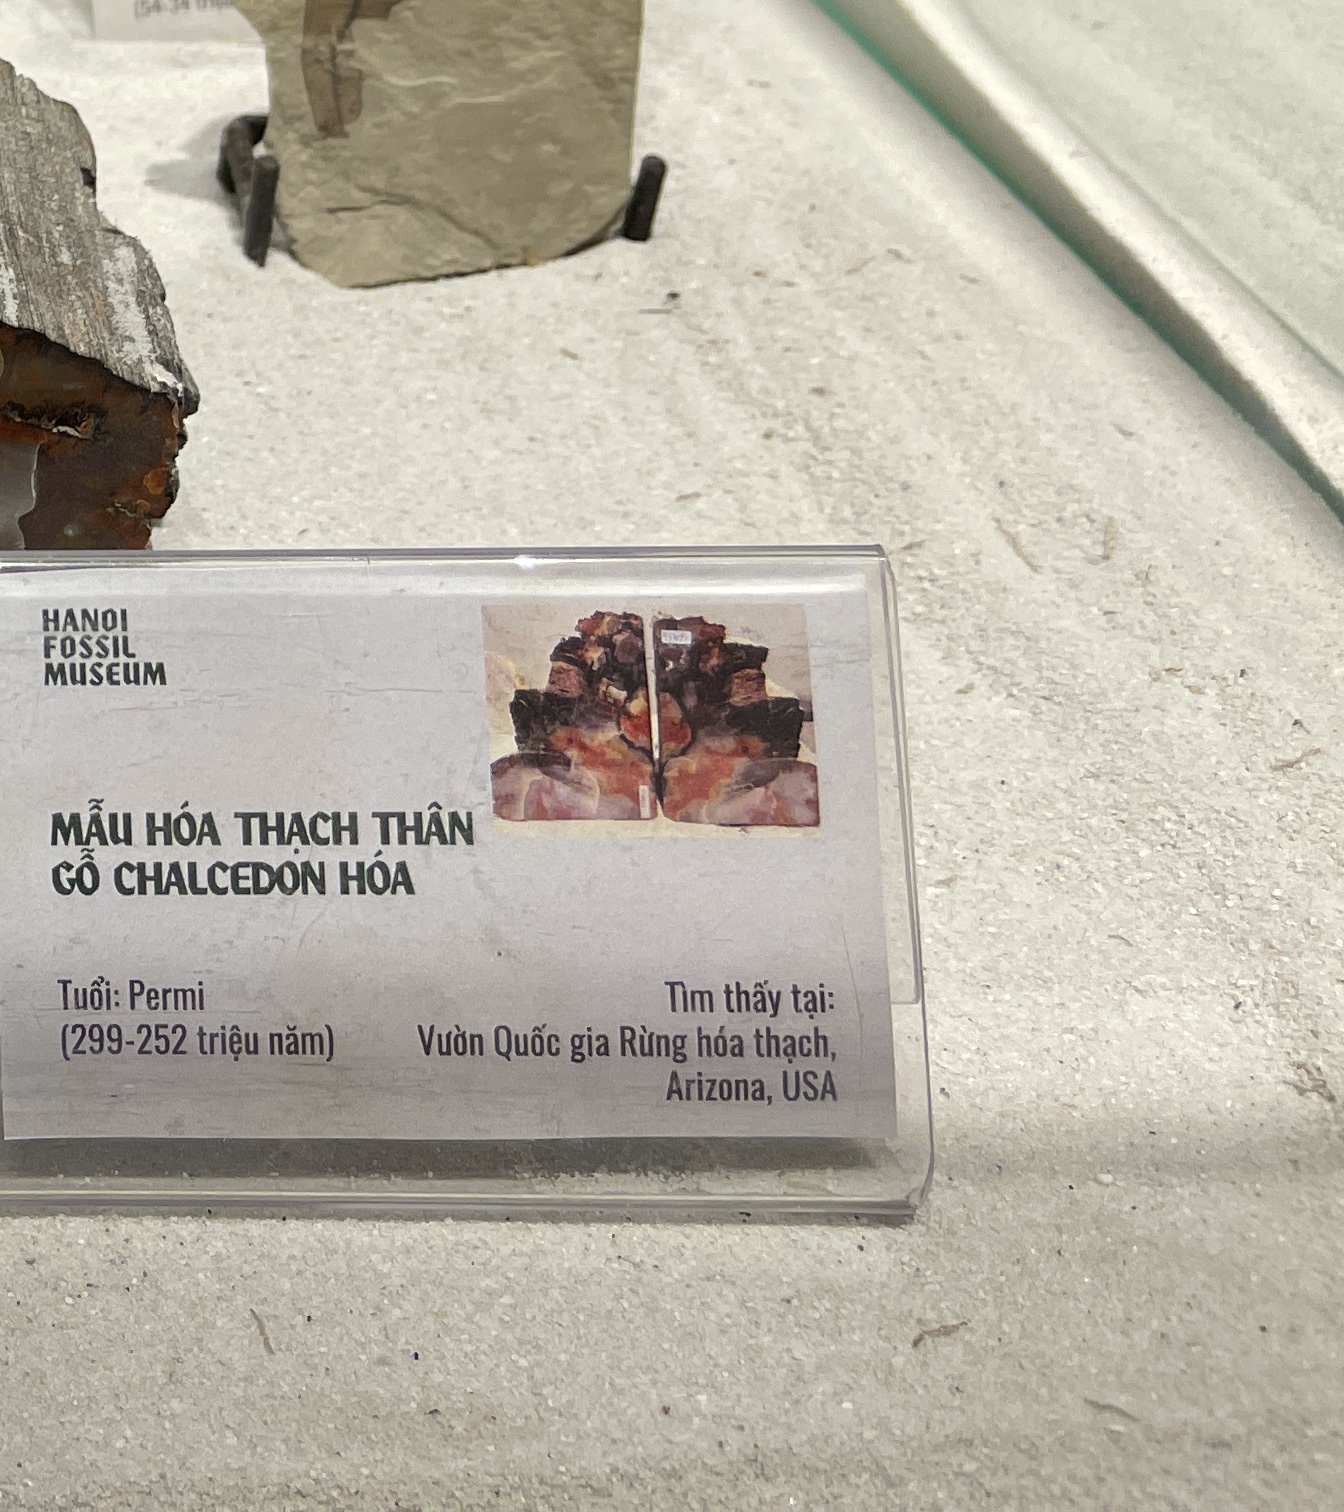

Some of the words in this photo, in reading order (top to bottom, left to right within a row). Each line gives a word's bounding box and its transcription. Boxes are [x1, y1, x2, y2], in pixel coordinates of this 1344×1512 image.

[42, 608, 128, 632] HANOI
[43, 634, 136, 659] FOSSIL
[44, 661, 167, 686] MUSEUM
[51, 798, 132, 846] MẪU
[146, 800, 221, 846] HÓA
[234, 811, 359, 855] THẠCH
[371, 801, 474, 846] THÂN
[52, 848, 100, 896] GỖ
[114, 860, 326, 896] CHALCEDON
[339, 849, 415, 896] HÓA
[57, 976, 120, 1011] Tuổi:
[128, 979, 205, 1011] Permi
[664, 980, 714, 1013] Tìm
[723, 979, 782, 1018] thấy
[790, 982, 835, 1020] tại:
[61, 1023, 188, 1061] (299-252
[196, 1024, 259, 1062] triệu
[269, 1023, 334, 1062] năm)
[417, 1023, 484, 1057] Vườn
[493, 1022, 561, 1062] Quốc
[570, 1026, 610, 1064] gia
[619, 1024, 688, 1064] Rừng
[697, 1025, 744, 1058] hóa
[753, 1025, 838, 1064] thạch,
[665, 1069, 773, 1106] Arizona,
[782, 1069, 838, 1102] USA
